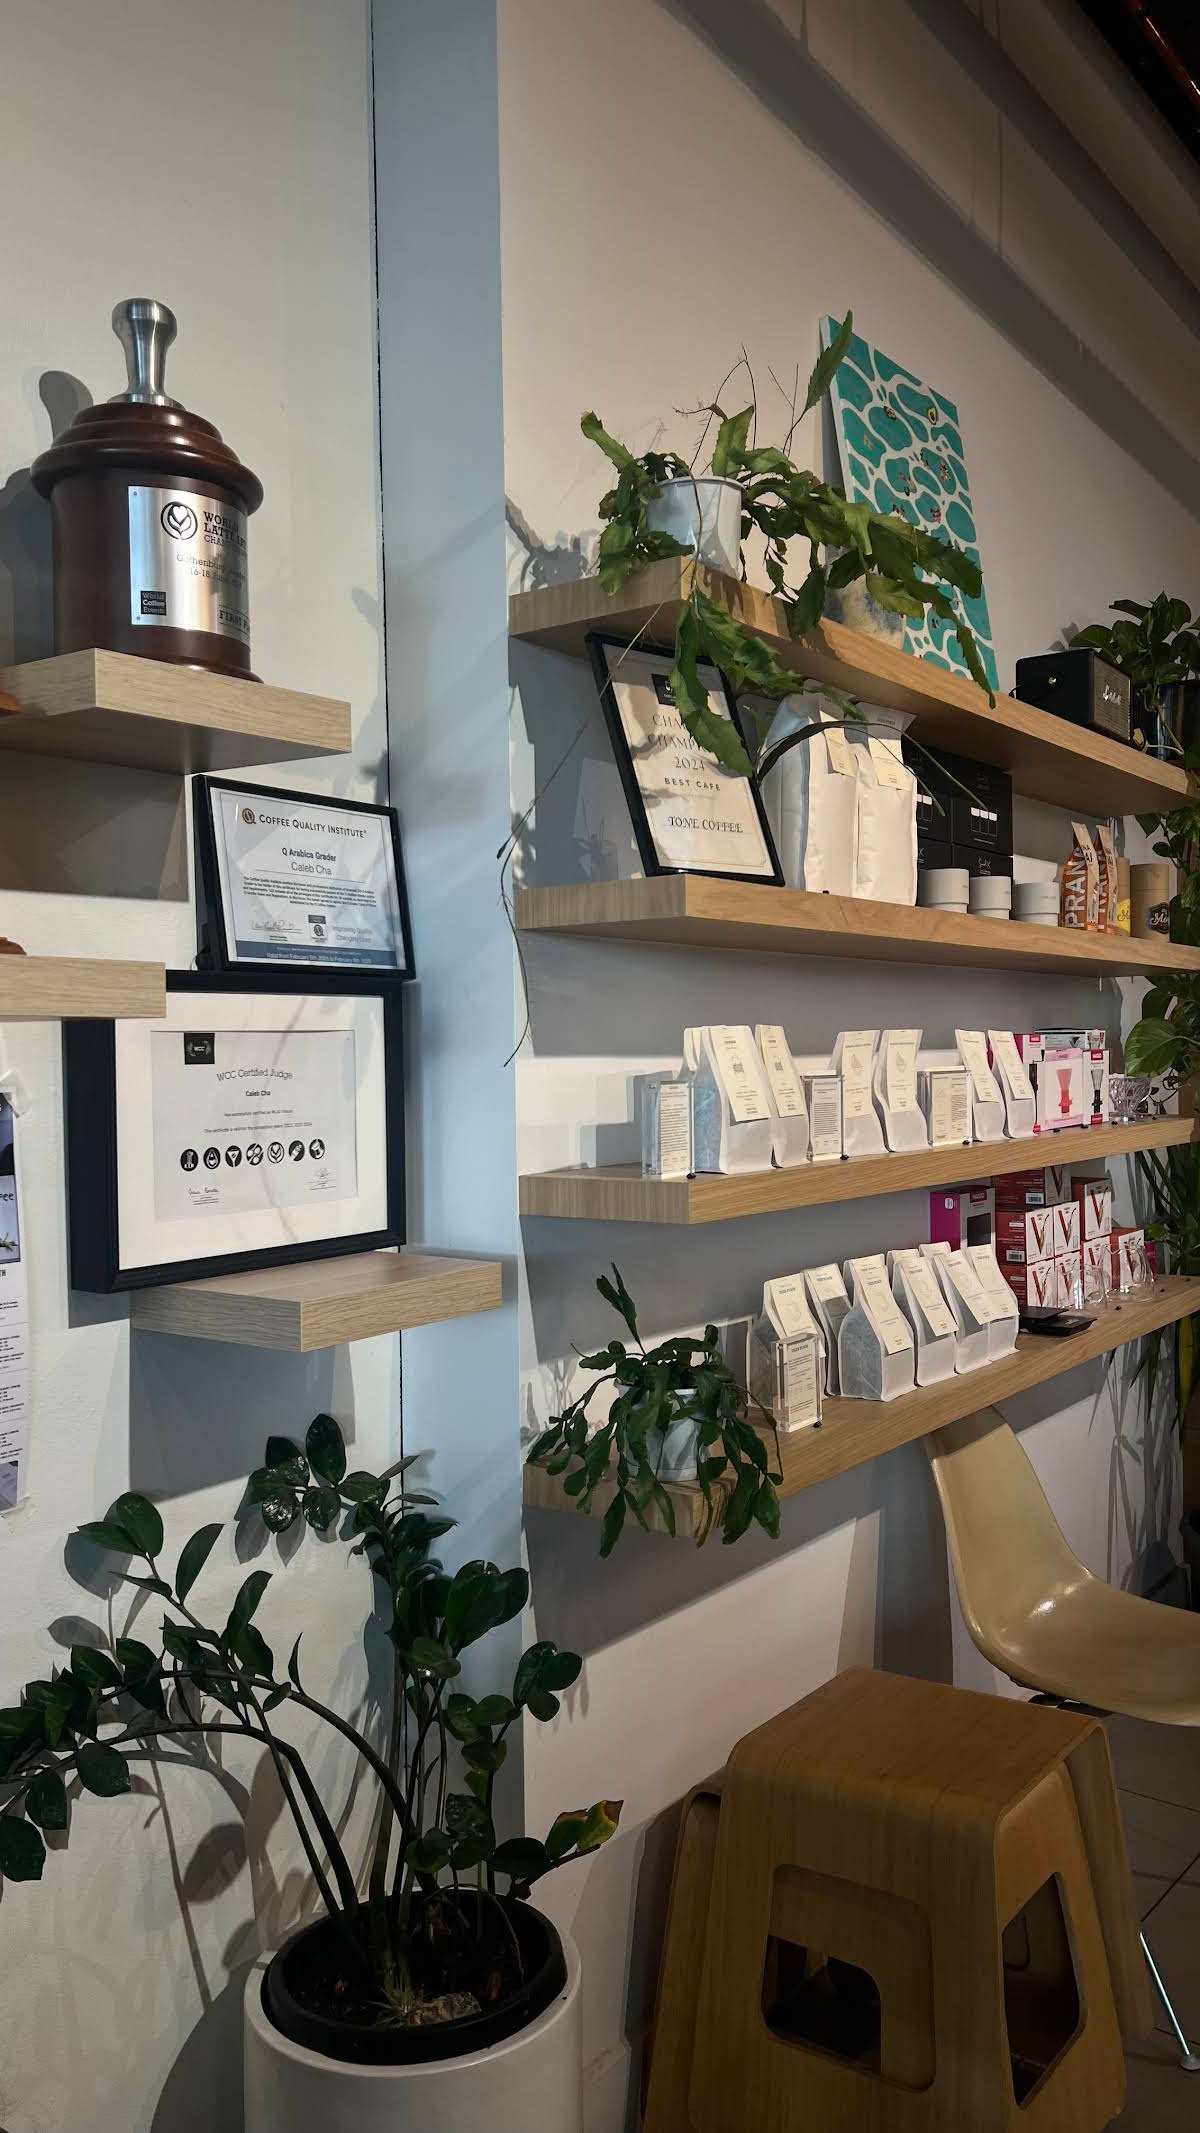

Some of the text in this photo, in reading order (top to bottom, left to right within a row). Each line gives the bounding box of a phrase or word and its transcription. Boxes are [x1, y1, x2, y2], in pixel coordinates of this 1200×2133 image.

[674, 756, 705, 771] 2024
[664, 778, 721, 791] BEST CAFE
[259, 814, 290, 827] COFFEE
[292, 819, 326, 832] QUALITY
[668, 816, 744, 833] TONE COFFEE
[281, 847, 336, 862] Q Arabica Grader
[291, 861, 332, 875] Caleb Cha
[216, 1068, 294, 1082] WCC Certified Judge
